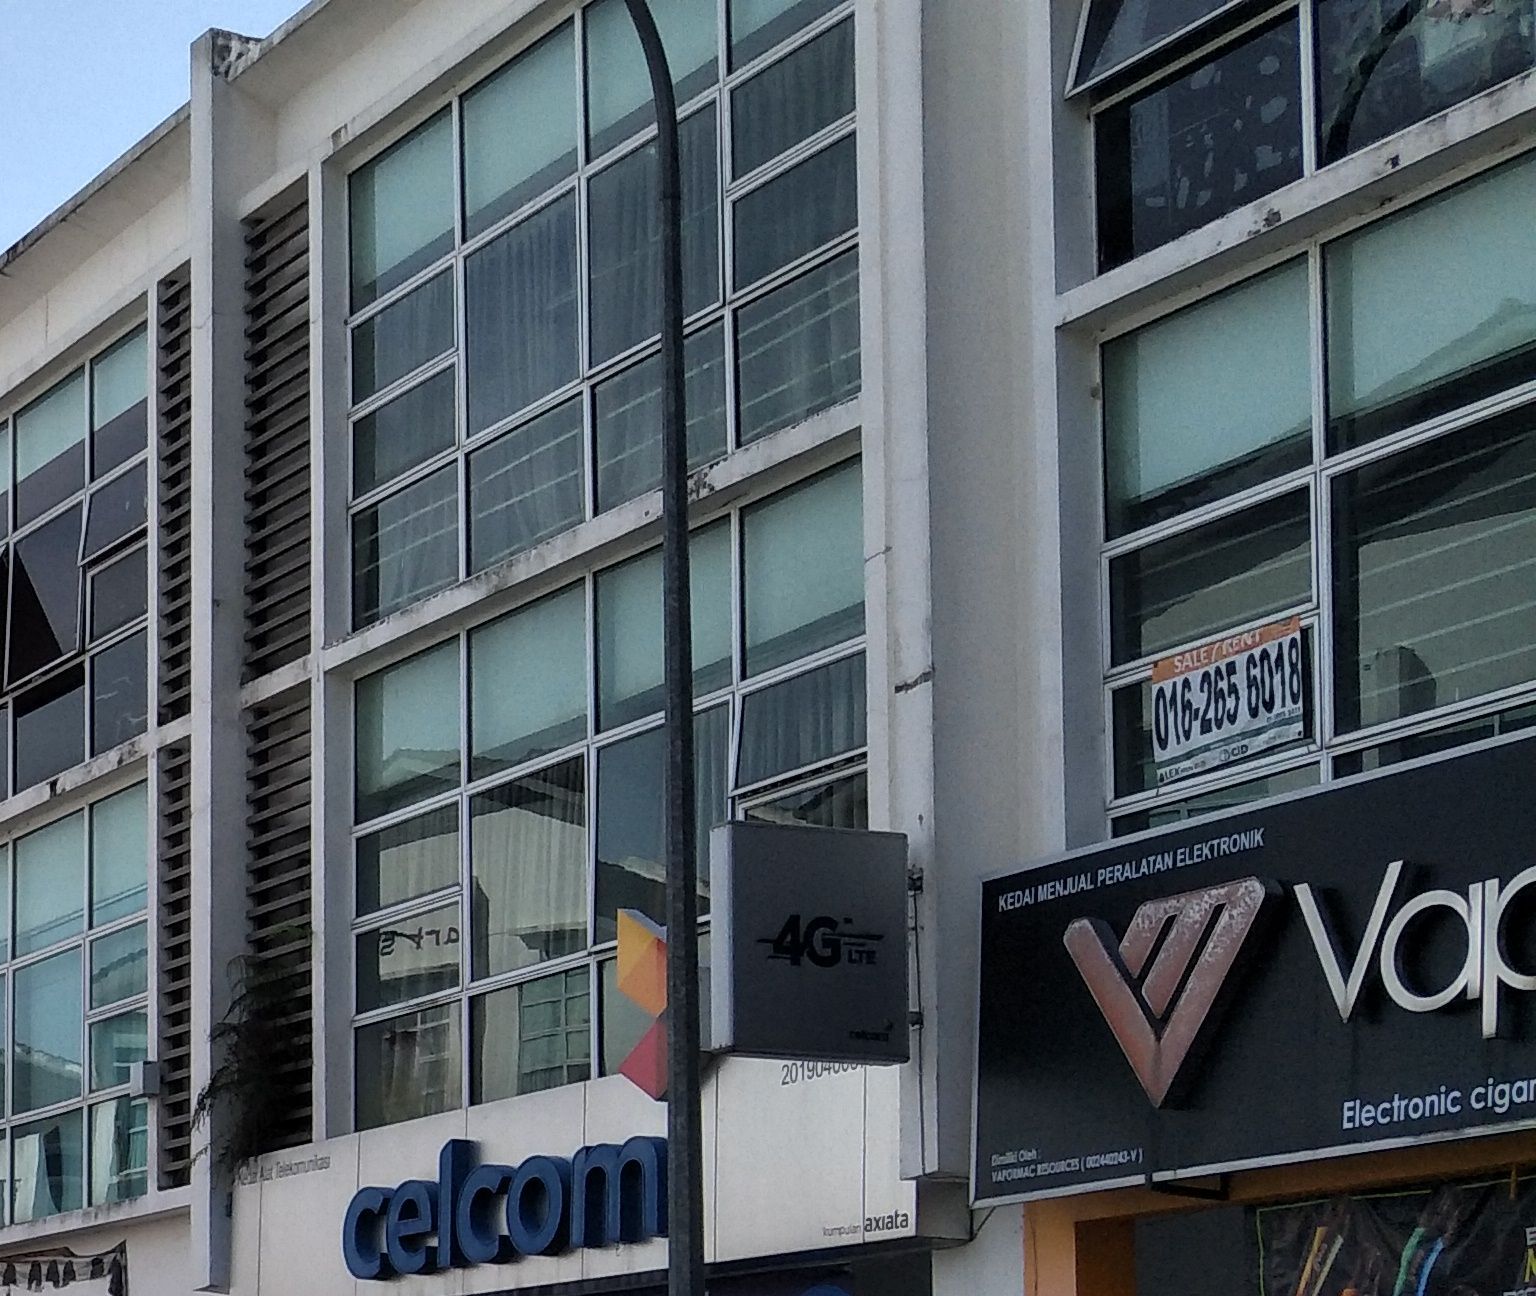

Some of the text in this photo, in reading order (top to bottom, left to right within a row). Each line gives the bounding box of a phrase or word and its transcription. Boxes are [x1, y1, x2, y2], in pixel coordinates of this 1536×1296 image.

[1155, 637, 1300, 751] 016-265 6018
[999, 828, 1265, 912] KEDAI MENJUAL PERALATAN ELEKTRONIK
[773, 914, 842, 968] 4G
[848, 950, 876, 965] LTE
[1342, 1085, 1462, 1130] Electronic
[1037, 1158, 1079, 1176] RESOURCES
[343, 1135, 668, 1279] celcom
[865, 1209, 909, 1233] axiata
